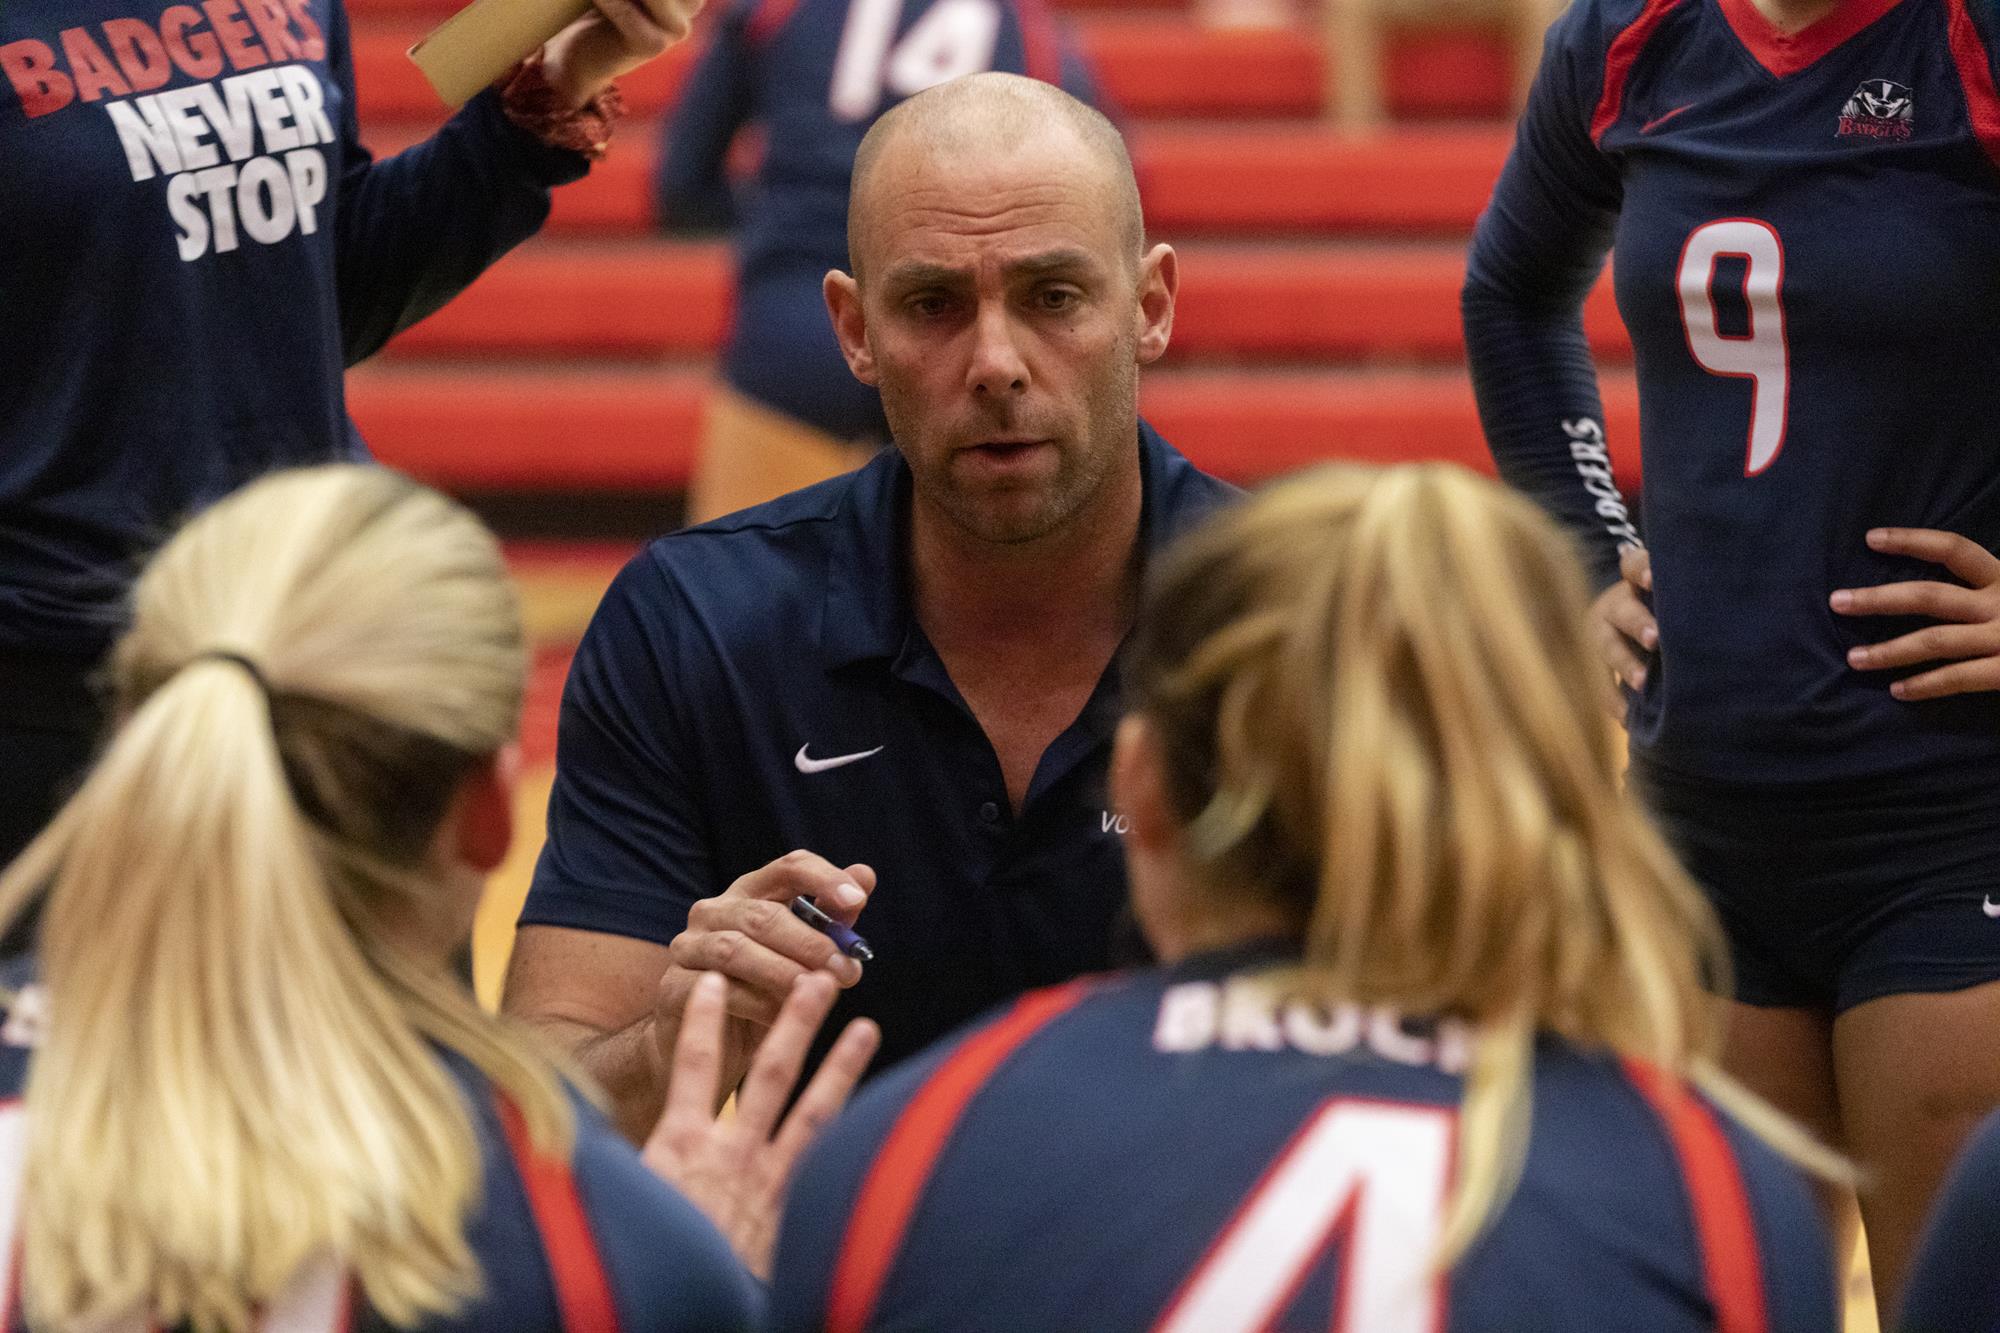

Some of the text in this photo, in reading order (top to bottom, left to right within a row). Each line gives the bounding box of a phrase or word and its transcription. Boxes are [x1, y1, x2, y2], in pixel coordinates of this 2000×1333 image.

[0, 0, 327, 119] BADGERS
[829, 0, 1001, 124] 14
[104, 64, 336, 182] NEVER
[166, 147, 328, 262] STOP
[1675, 216, 1790, 478] 9
[1561, 417, 1646, 555] ADGERS
[1148, 1095, 1462, 1333] 4
